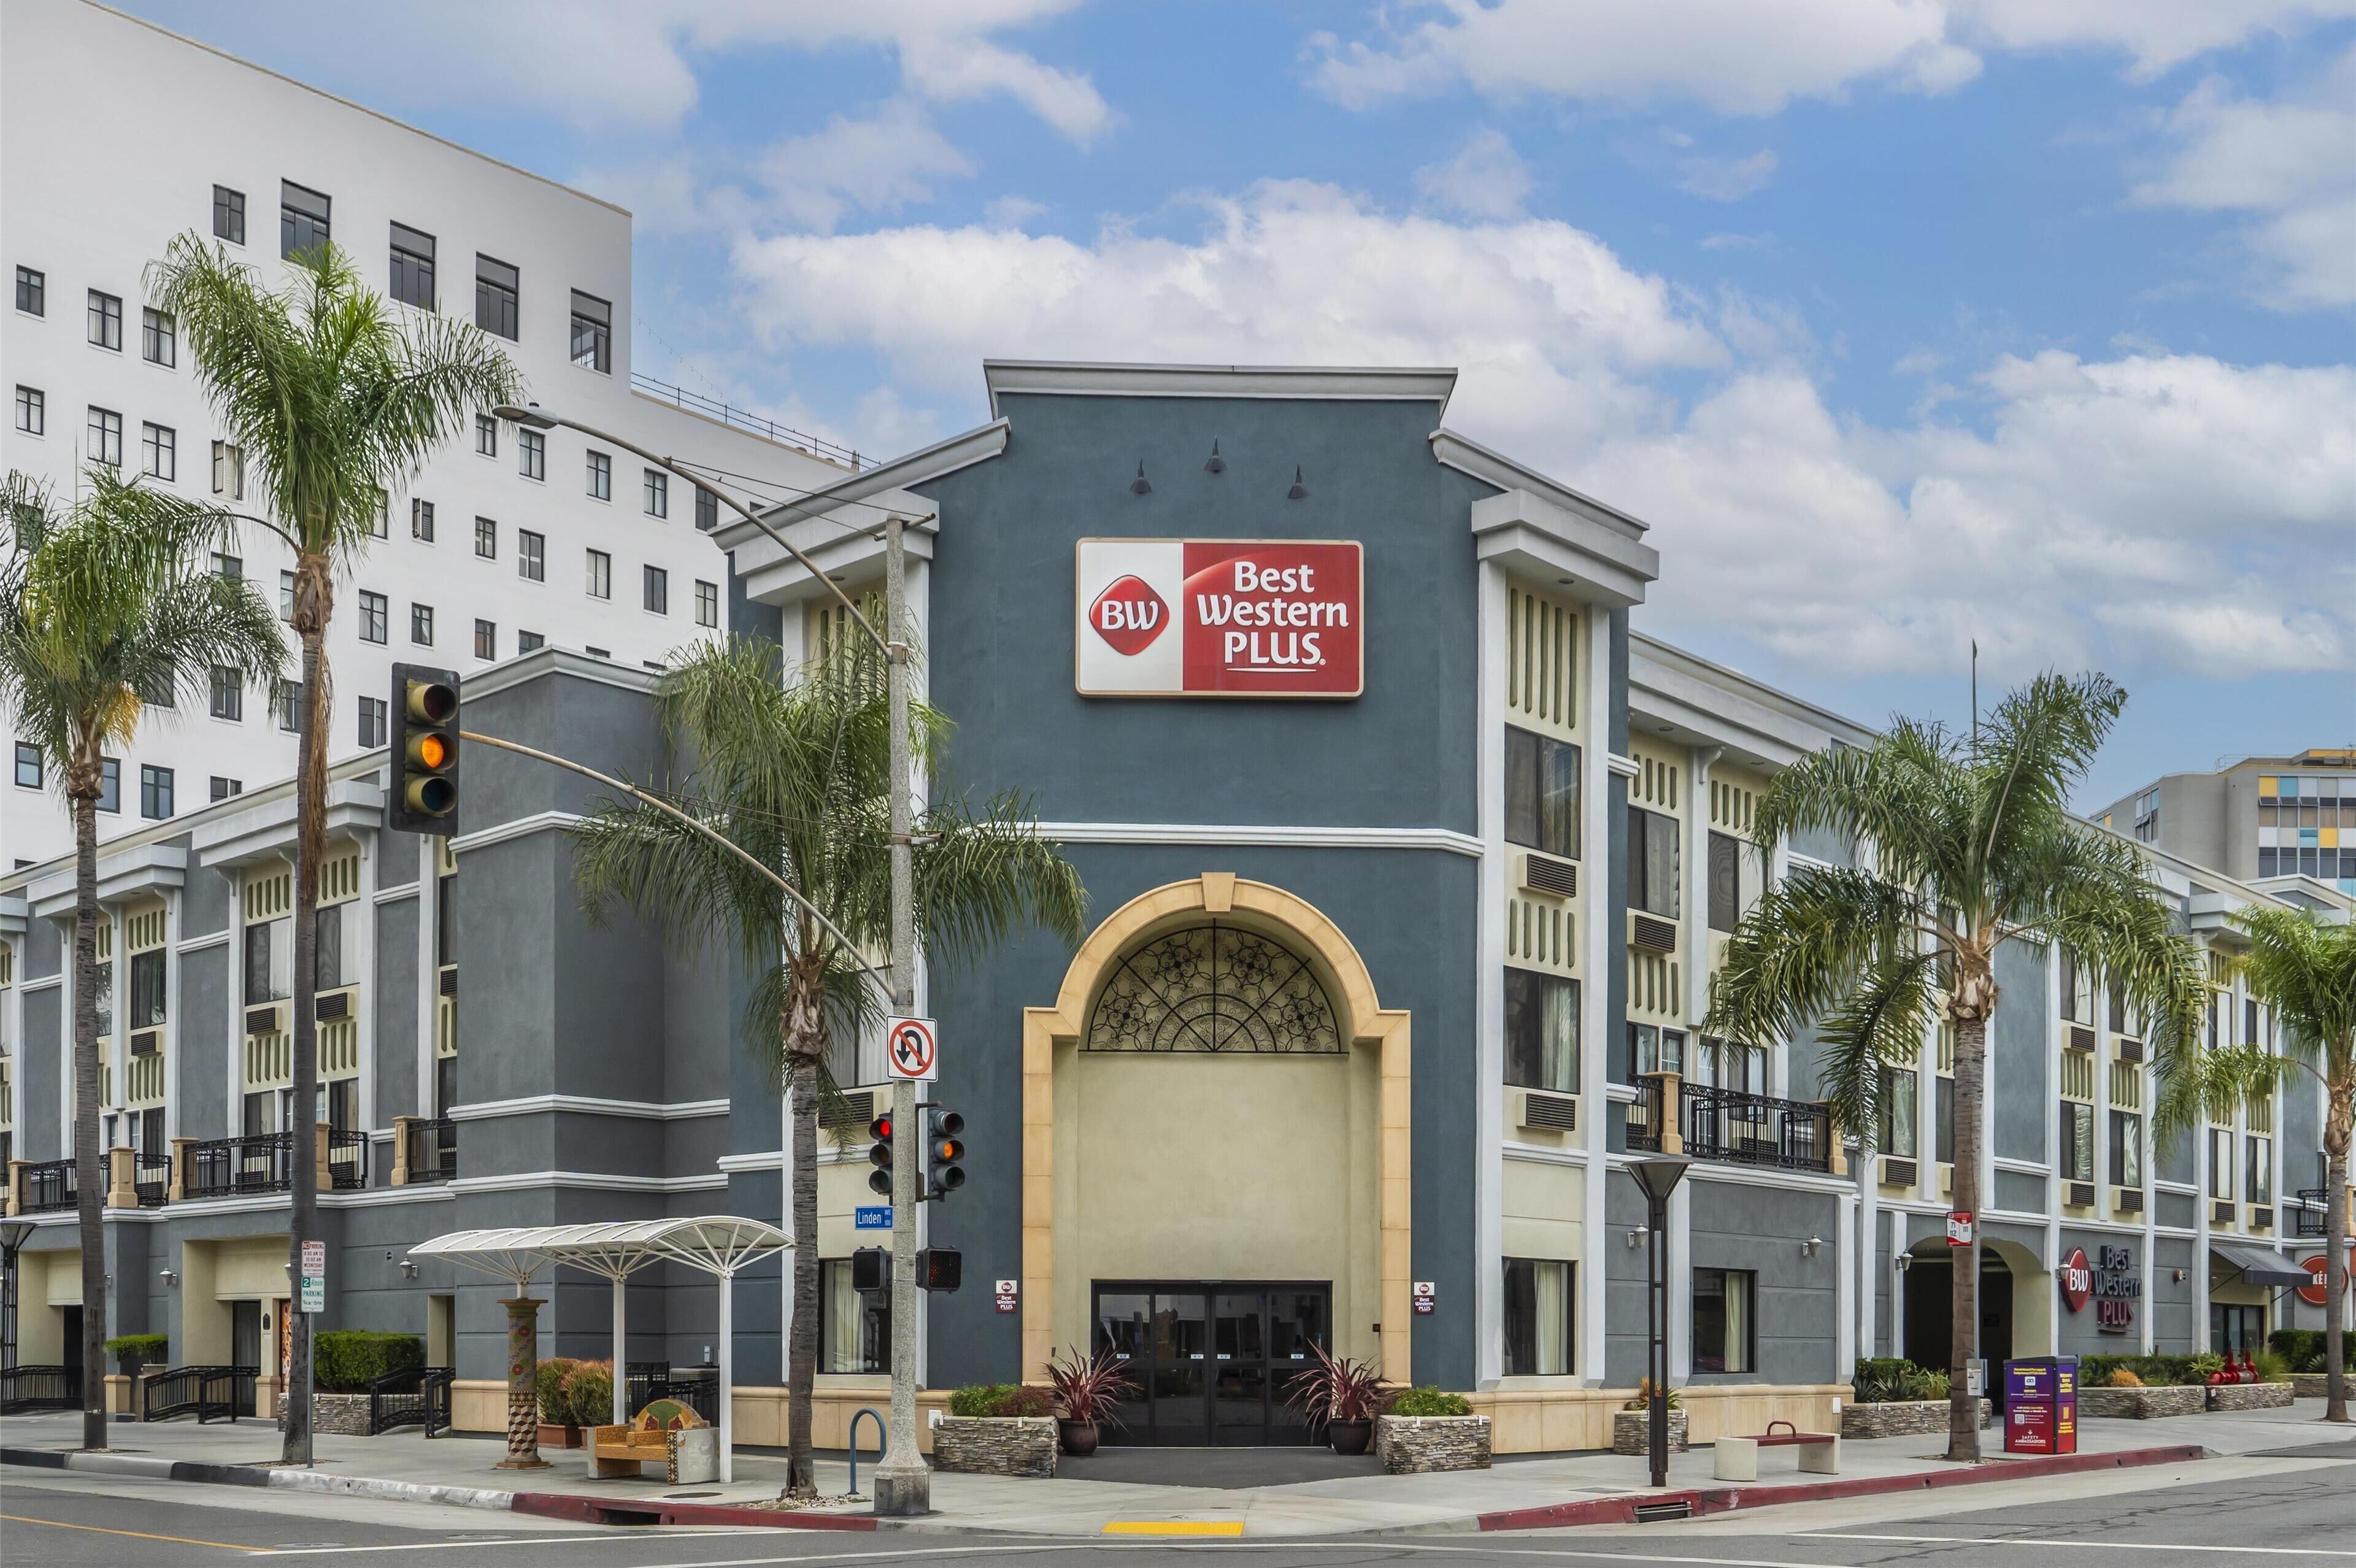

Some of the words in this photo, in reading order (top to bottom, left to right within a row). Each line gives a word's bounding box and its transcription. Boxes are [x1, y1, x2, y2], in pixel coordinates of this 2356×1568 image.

[1234, 561, 1315, 593] Best
[1101, 600, 1158, 630] BW
[1196, 594, 1349, 628] Western
[858, 1212, 882, 1224] Linden
[2105, 1245, 2132, 1270] Best
[303, 1278, 309, 1287] 2
[2069, 1268, 2089, 1293] BW
[2093, 1270, 2142, 1297] Western
[2103, 1301, 2135, 1326] PLUS
